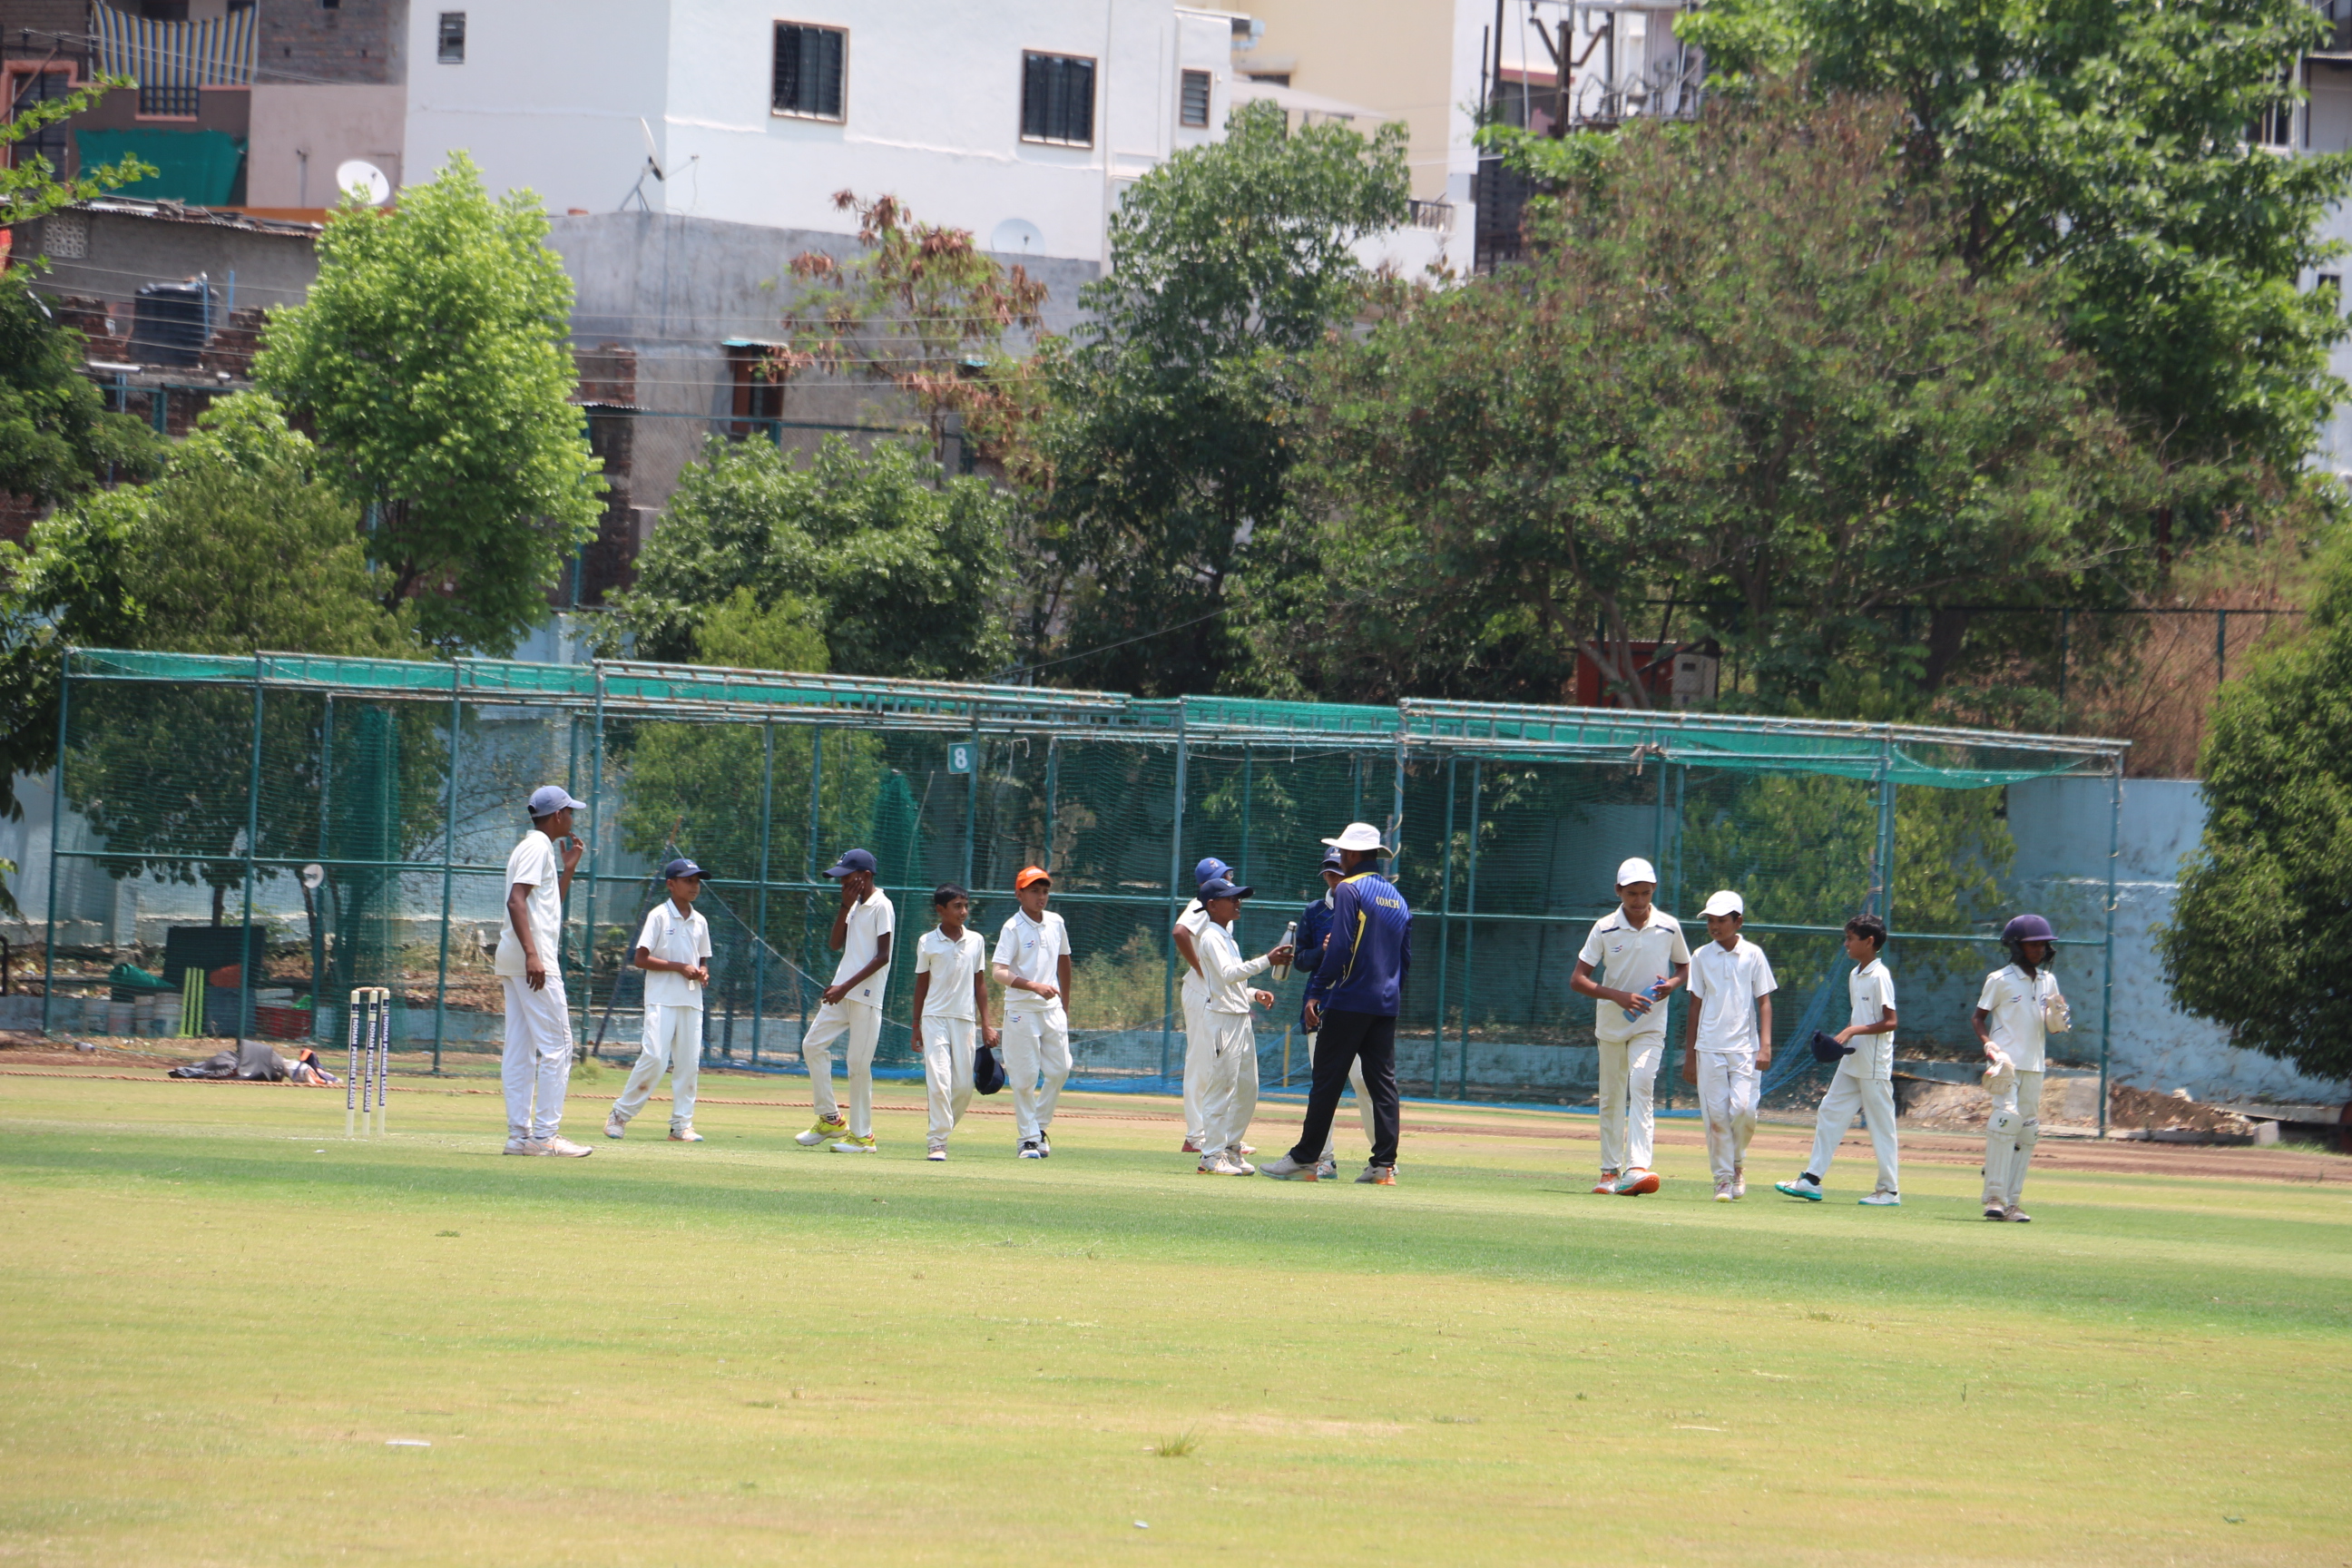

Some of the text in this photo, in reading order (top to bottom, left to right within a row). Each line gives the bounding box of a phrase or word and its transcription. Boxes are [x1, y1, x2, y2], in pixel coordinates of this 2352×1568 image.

[955, 748, 967, 769] 8
[1376, 896, 1399, 908] COACH
[368, 1022, 377, 1047] ROHAN
